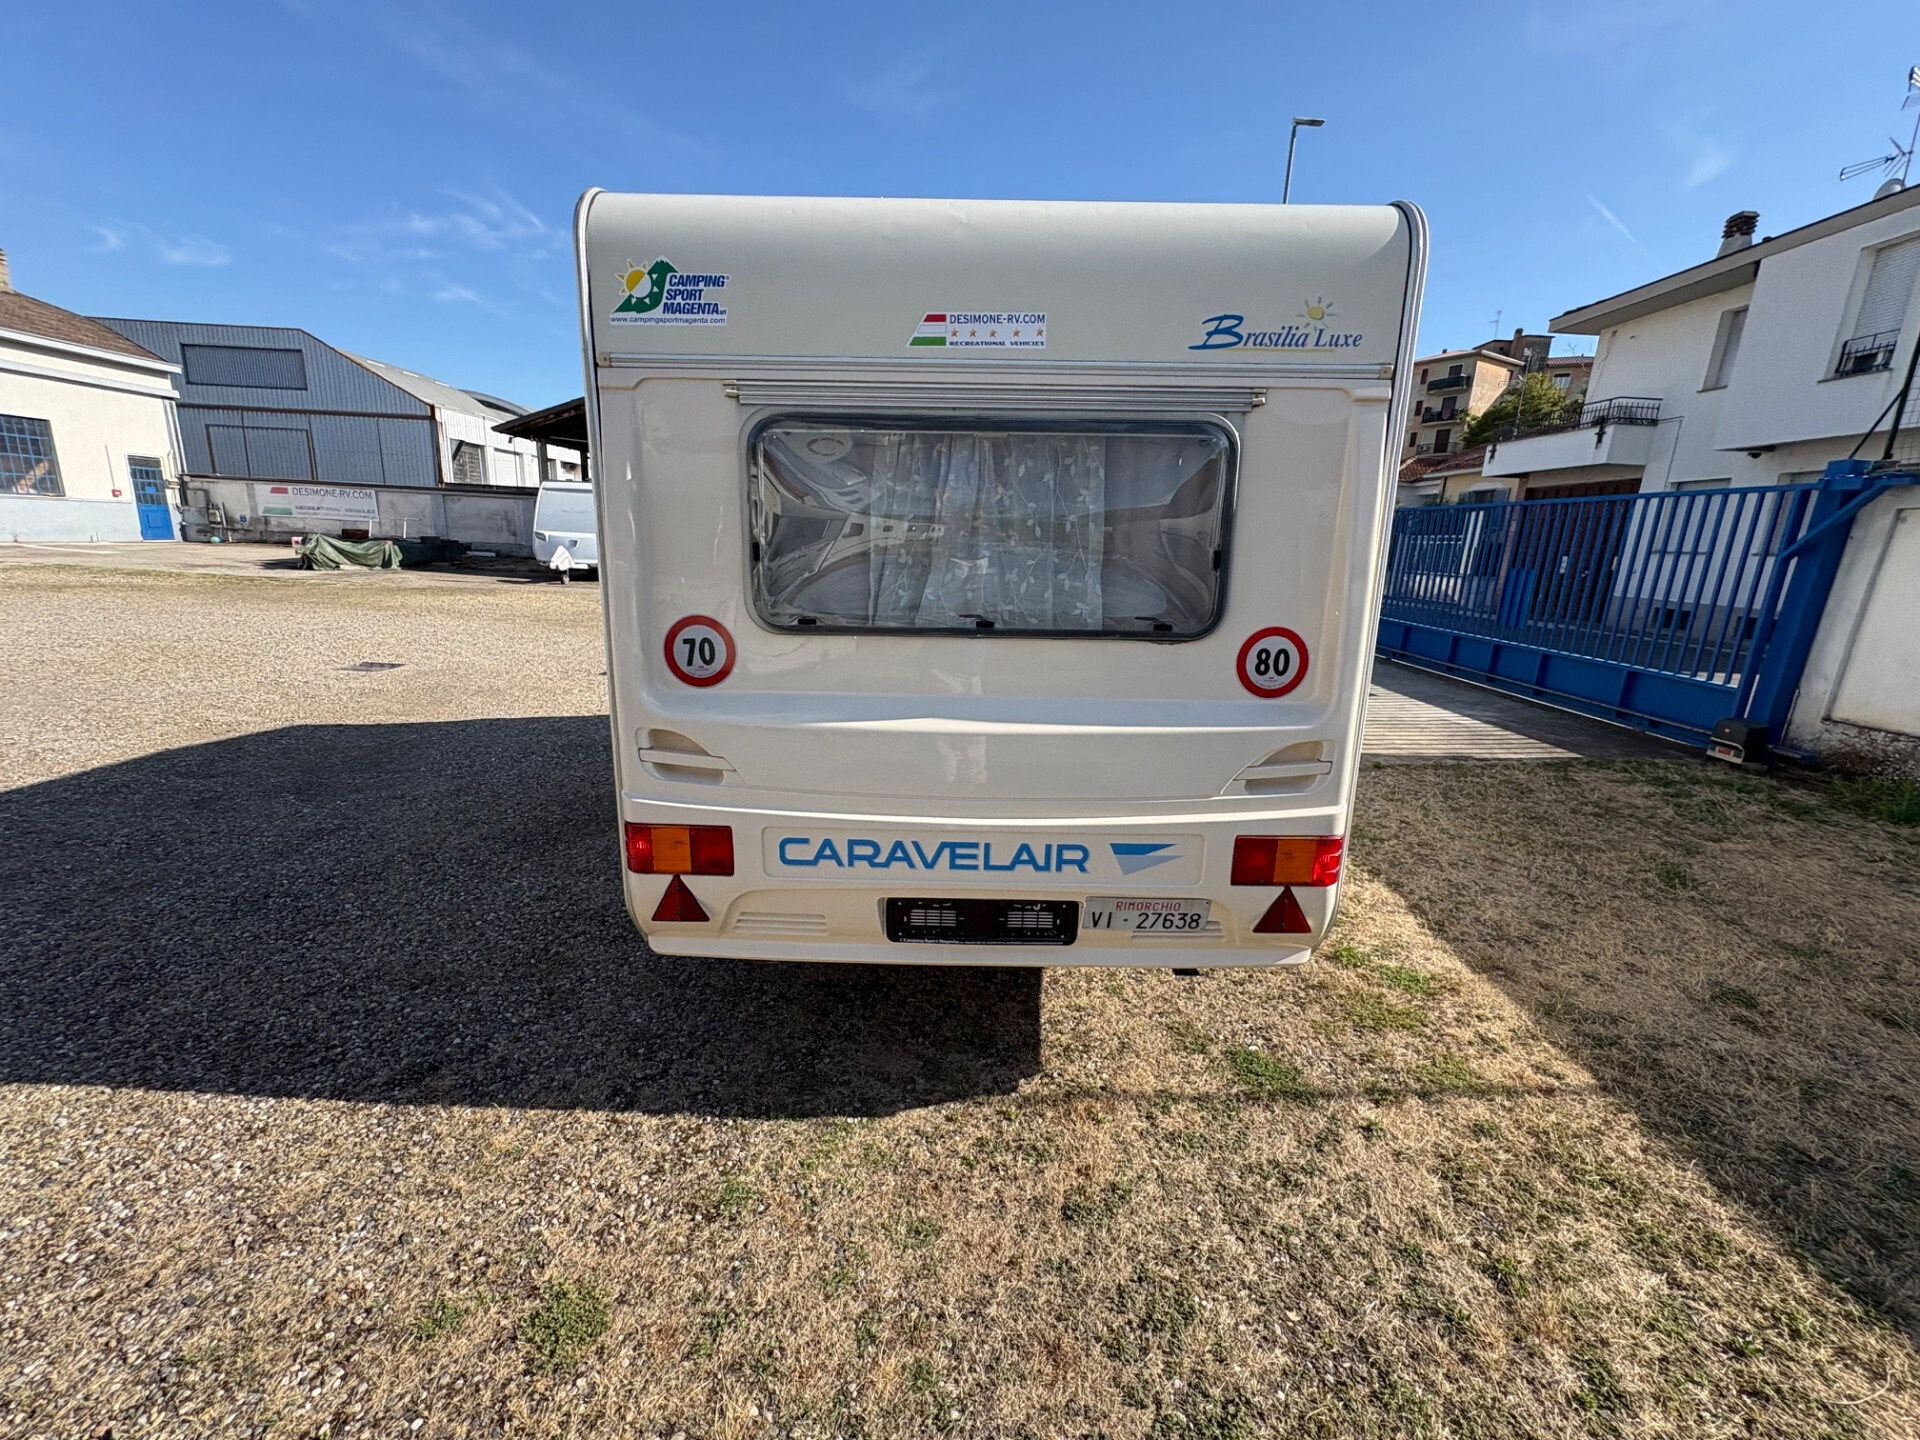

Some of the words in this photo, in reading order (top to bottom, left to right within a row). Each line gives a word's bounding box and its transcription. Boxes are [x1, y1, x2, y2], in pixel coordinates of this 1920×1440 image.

[668, 274, 726, 288] CAMPING
[665, 288, 705, 302] SPORT
[662, 301, 719, 315] MAGENTA
[610, 316, 726, 325] www.campingsportmagenta.com
[949, 313, 1046, 324] DESIMONE-RV.COM
[1313, 328, 1363, 348] Luxe
[291, 487, 374, 500] DESIMONE-RV.COM
[682, 637, 716, 667] 70
[1254, 647, 1291, 677] 80
[778, 837, 1090, 874] CARAVELAIR
[1115, 901, 1181, 911] RIMORCHIO
[1091, 911, 1113, 928] VI
[1135, 912, 1202, 929] 27638
